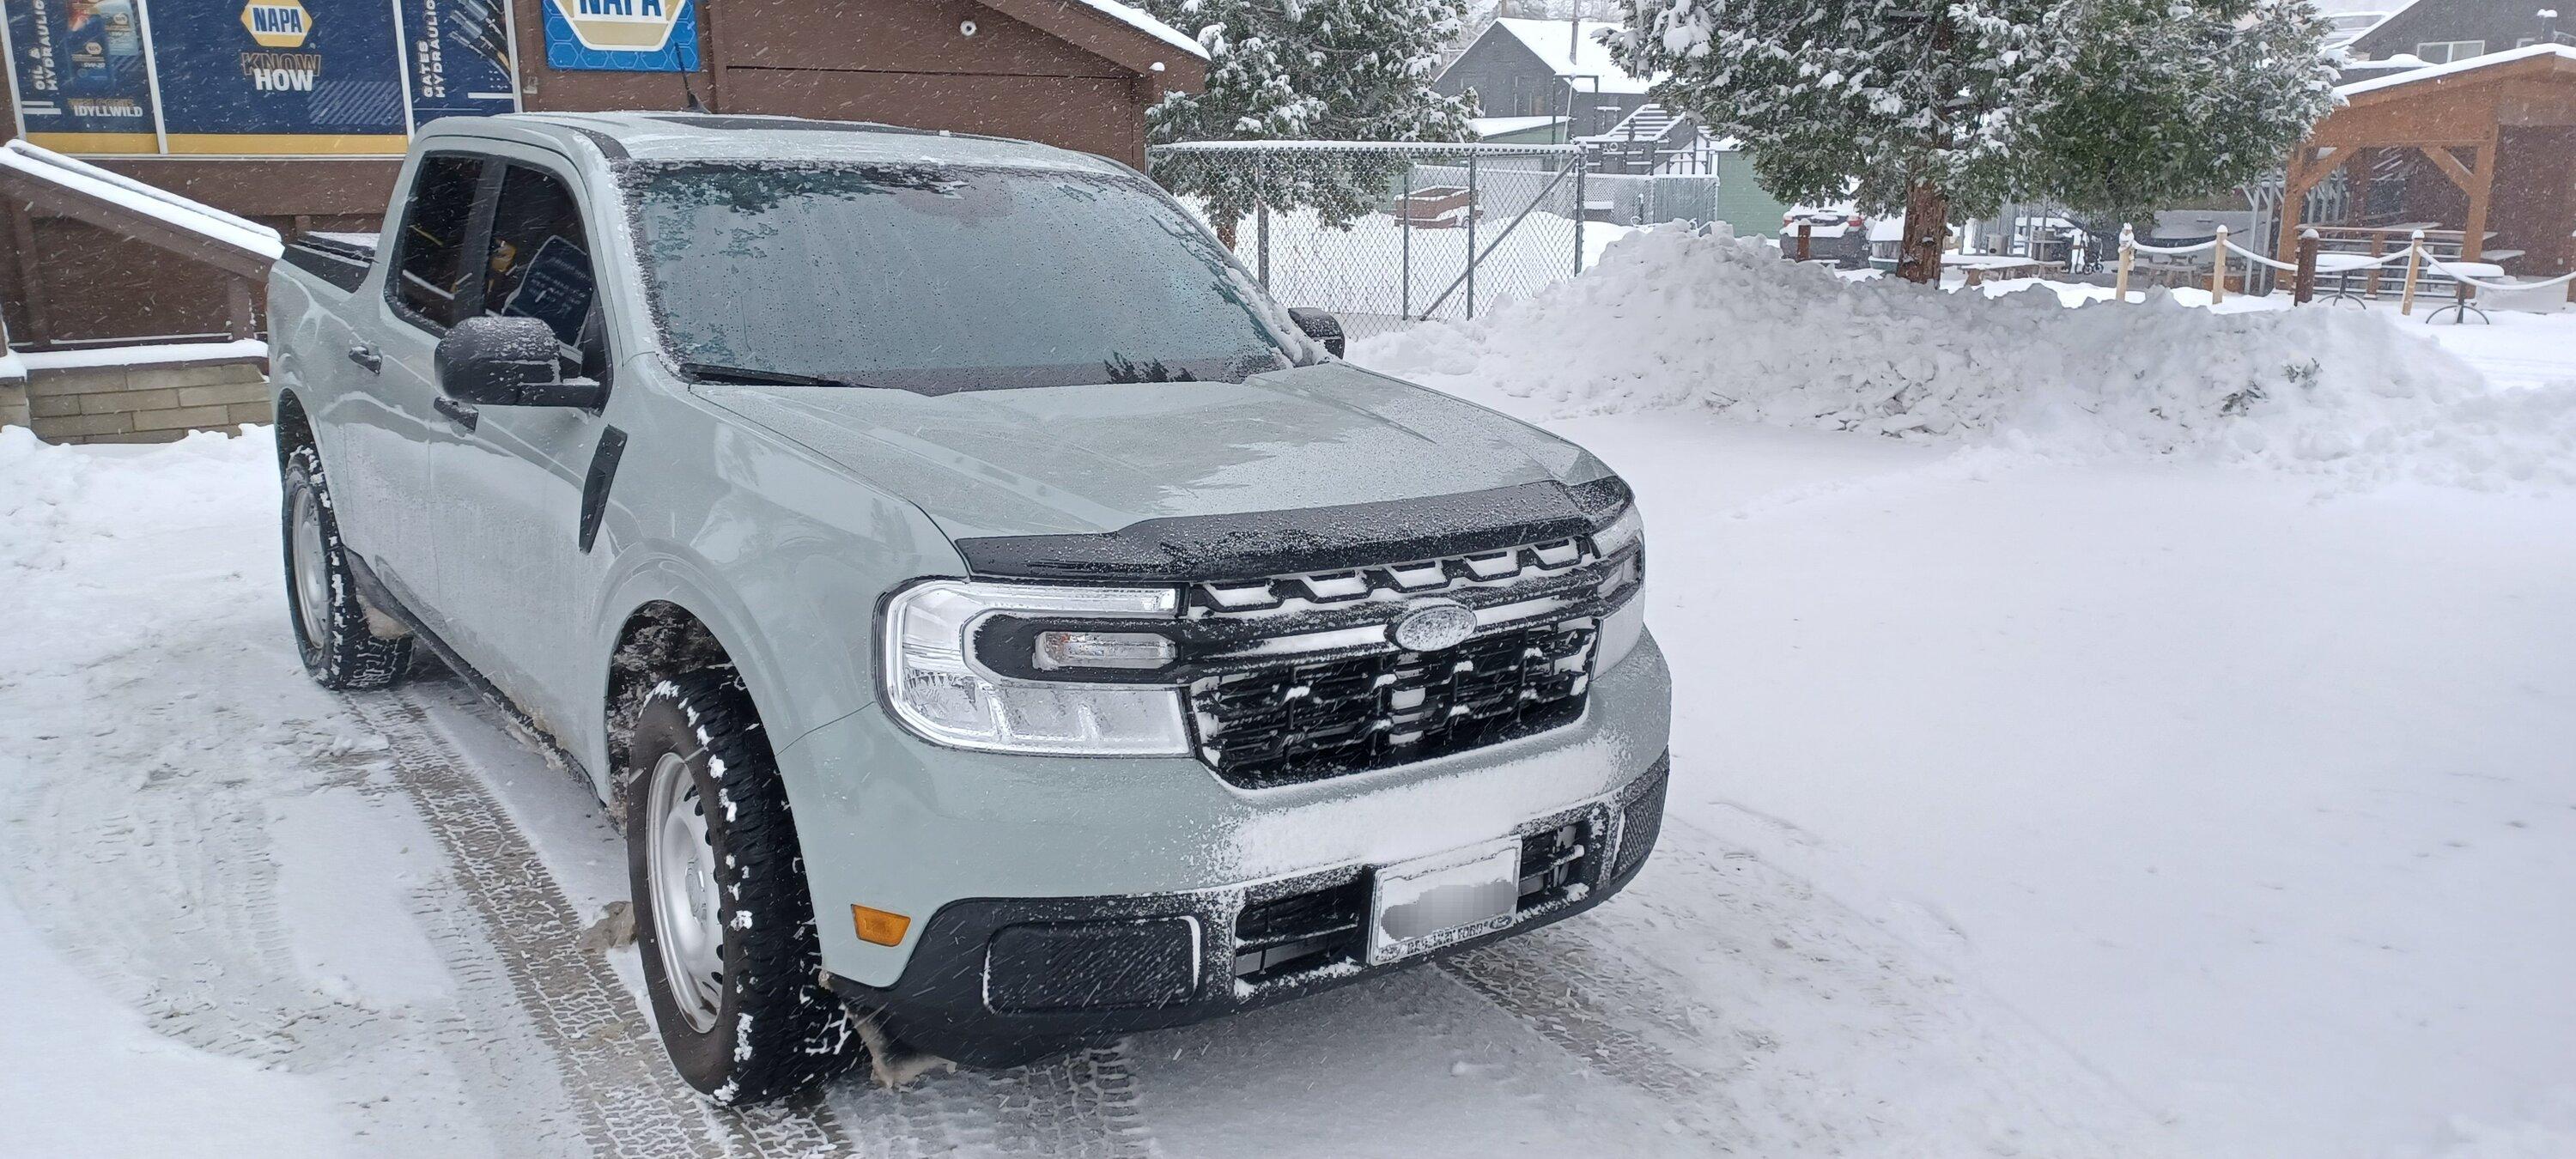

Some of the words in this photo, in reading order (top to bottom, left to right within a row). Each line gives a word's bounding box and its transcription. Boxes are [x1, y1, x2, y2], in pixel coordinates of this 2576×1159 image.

[252, 7, 302, 33] NAPA
[241, 52, 321, 76] KNOW
[418, 40, 433, 97] GATES
[33, 65, 46, 90] OIL
[253, 68, 313, 92] HOW
[74, 105, 143, 118] IDYLLWILD
